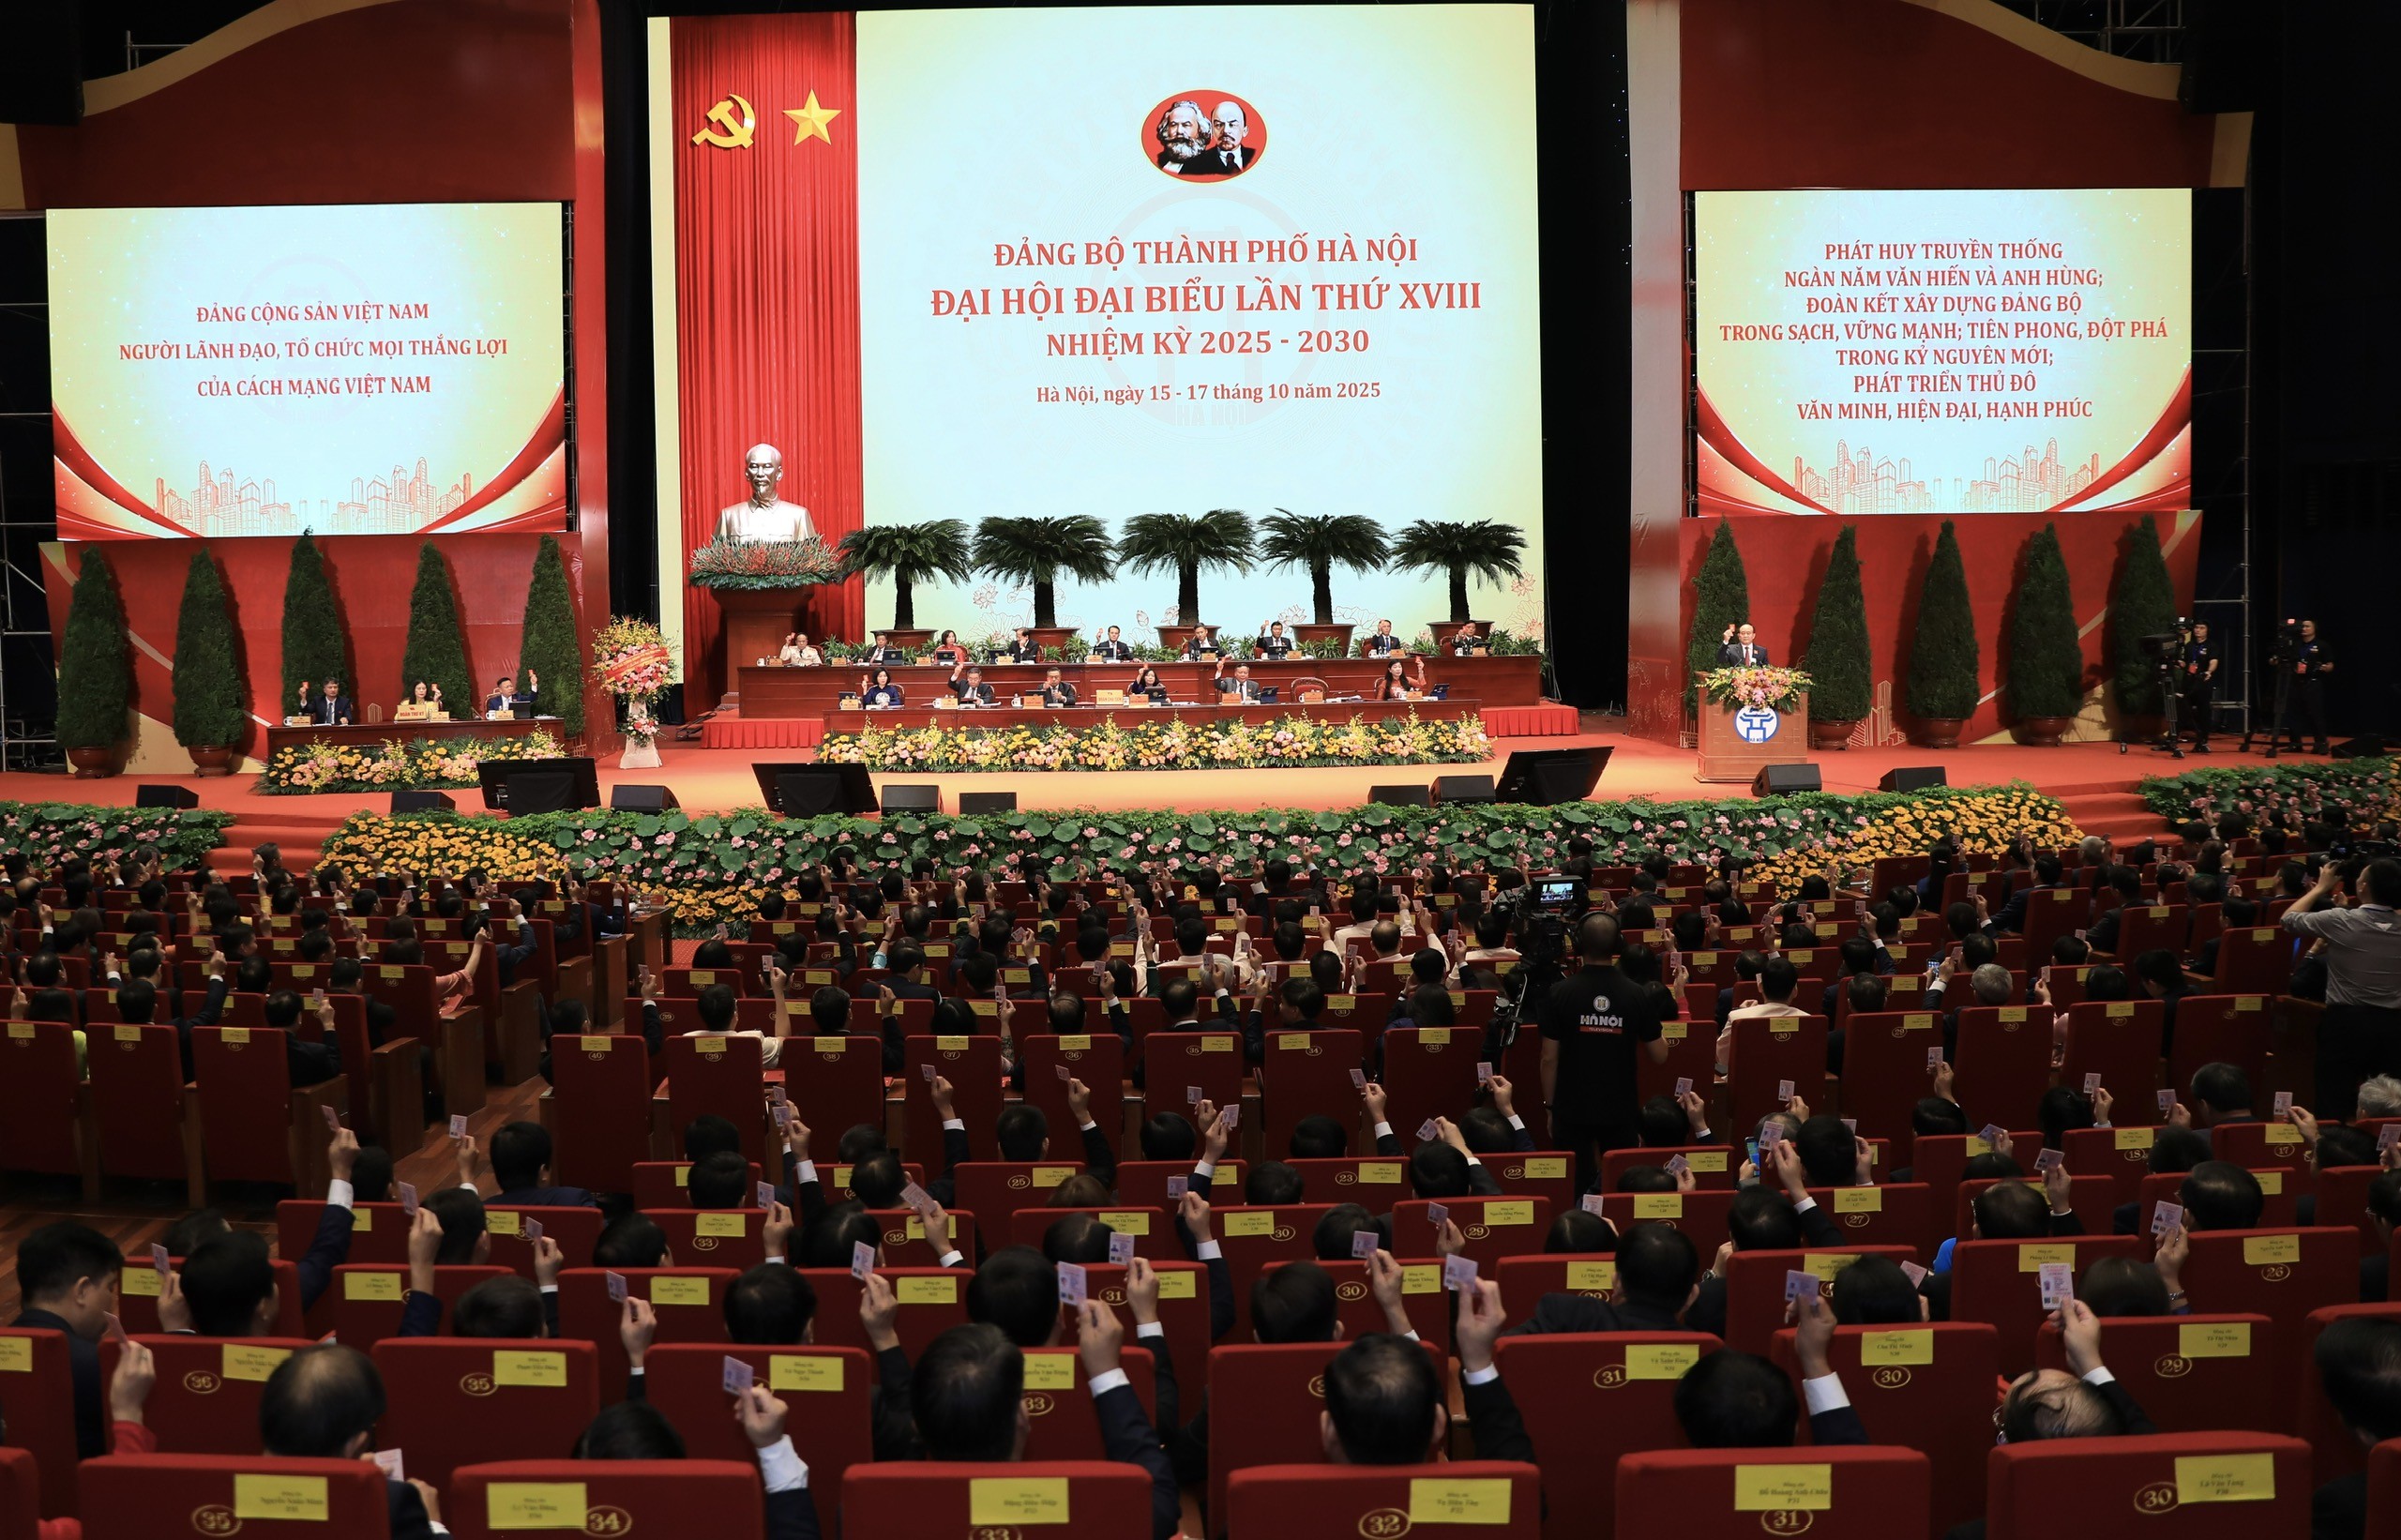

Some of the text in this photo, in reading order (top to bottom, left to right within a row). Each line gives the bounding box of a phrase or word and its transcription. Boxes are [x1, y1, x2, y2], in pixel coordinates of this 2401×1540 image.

[993, 232, 1418, 271] ĐẢNG BỘ THÀNH PHỐ HÀ NỘI
[1825, 237, 2063, 260] PHÁT HUY TRUYỀN THỐNG
[1784, 264, 2103, 288] NGÀN NĂM VĂN HIẾN VÀ ANH HÙNG;
[930, 276, 1481, 322] ĐẠI HỘI ĐẠI BIỂU LẦN THỨ XVIII
[1805, 291, 2082, 317] ĐOÀN KẾT XÂY DỰNG ĐẢNG BỘ
[196, 300, 429, 325] ĐẢNG CỘNG SẢN VIỆT NAM
[1719, 316, 2168, 344] TRONG SẠCH, VỮNG MẠNH; TIÊN PHONG, ĐỘT PHÁ
[119, 333, 507, 362] NGƯỜI LÃNH ĐẠO, TỔ CHỨC MỌI THẮNG LỢI
[1047, 326, 1144, 362] NHIỆM
[1153, 325, 1193, 355] KỲ
[1200, 329, 1272, 355] 2025
[1298, 329, 1369, 353] 2030
[1835, 343, 2053, 367] TRONG KỶ NGUYÊN MỚI;
[197, 372, 430, 399] CỦA CÁCH MẠNG VIỆT NAM
[1853, 369, 2036, 393] PHÁT TRIỂN THỦ ĐÔ
[1036, 385, 1061, 402] Hà
[1065, 385, 1099, 406] Nội,
[1103, 385, 1145, 406] ngày
[1150, 385, 1170, 400] 15
[1187, 385, 1208, 400] 17
[1213, 383, 1263, 404] tháng
[1268, 384, 1290, 399] 10
[1293, 383, 1332, 399] năm
[1336, 382, 1381, 399] 2025
[1796, 397, 2092, 423] VĂN MINH, HIỆN ĐẠI, HẠNH PHÚC
[1777, 1032, 1789, 1040] 30
[1188, 1046, 1200, 1055] 35
[1307, 1046, 1320, 1054] 34
[1428, 1043, 1440, 1051] 33
[591, 1051, 602, 1060] 40
[707, 1052, 719, 1061] 39
[825, 1052, 837, 1061] 38
[946, 1050, 958, 1059] 37
[1068, 1050, 1080, 1060] 36
[2128, 1150, 2140, 1159] 18
[2278, 1146, 2290, 1155] 17
[1340, 1174, 1353, 1183] 23
[1508, 1169, 1521, 1177] 22
[1850, 1215, 1864, 1224] 27
[888, 1233, 905, 1243] 32
[1275, 1229, 1290, 1238] 30
[1469, 1227, 1484, 1236] 29
[698, 1238, 713, 1247] 33
[2267, 1267, 2284, 1277] 26
[1106, 1291, 1122, 1301] 31
[1341, 1286, 1360, 1296] 30
[2161, 1358, 2183, 1373] 29
[190, 1375, 212, 1388] 36
[1602, 1369, 1622, 1384] 31
[1880, 1370, 1902, 1382] 30
[468, 1378, 490, 1391] 35
[1024, 1397, 1045, 1410] 33
[2143, 1488, 2172, 1508] 30
[202, 1512, 232, 1525] 35
[589, 1512, 620, 1531] 34
[1369, 1515, 1400, 1534] 32
[1774, 1510, 1800, 1528] 31
